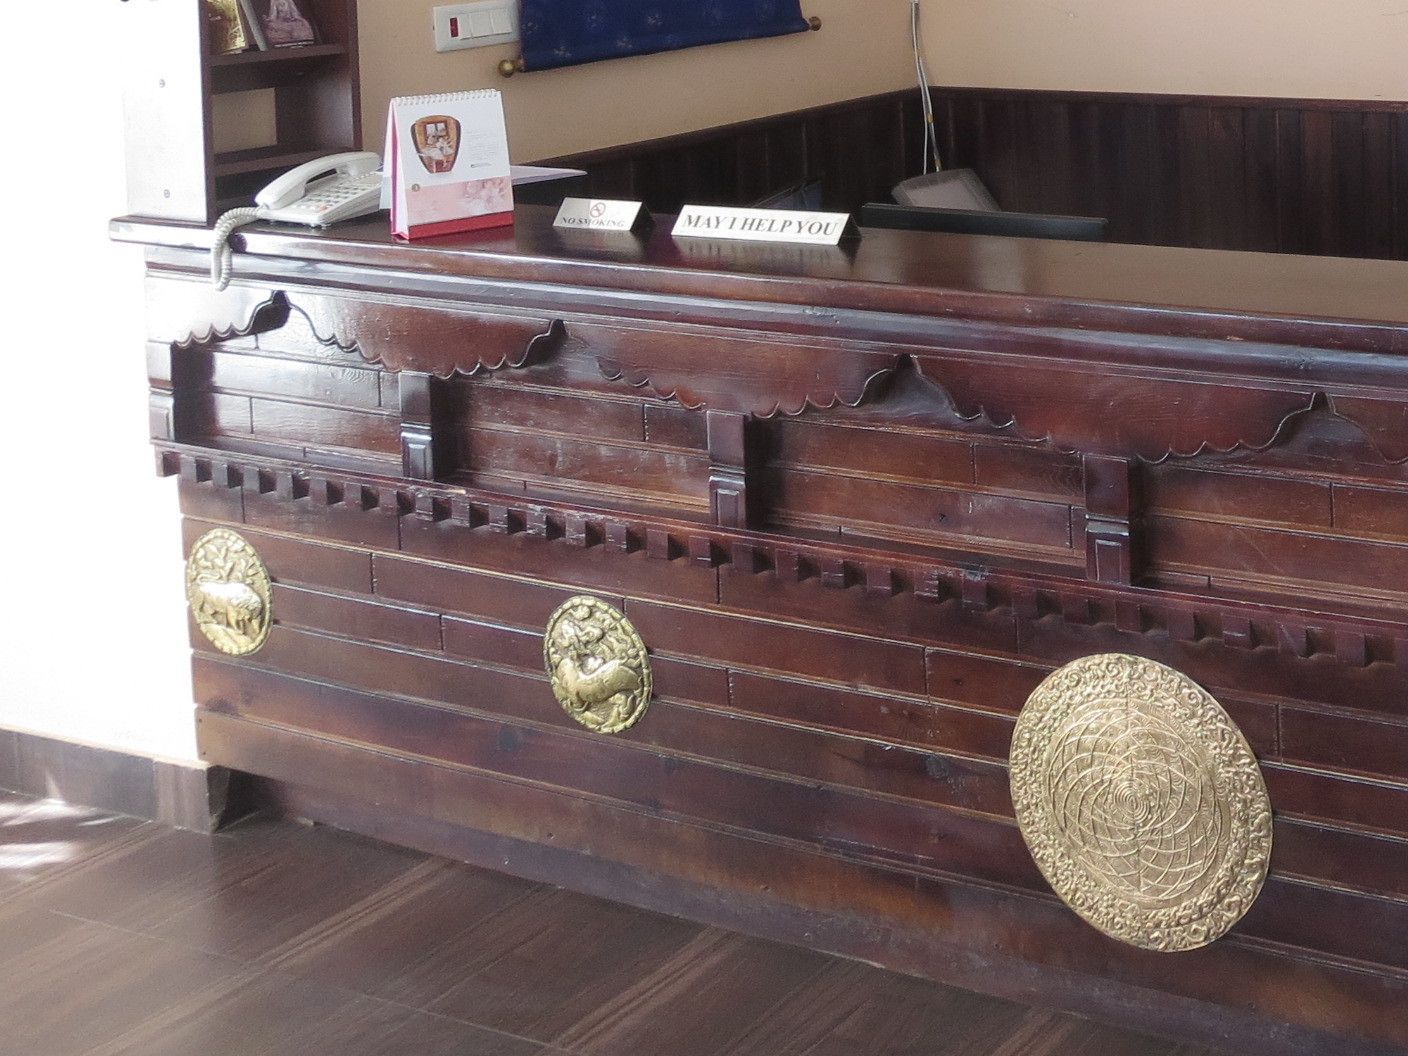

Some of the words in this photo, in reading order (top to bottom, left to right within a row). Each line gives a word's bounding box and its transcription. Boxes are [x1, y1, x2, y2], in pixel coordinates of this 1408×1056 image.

[561, 217, 576, 225] NO
[578, 217, 625, 227] SMOKING
[683, 214, 726, 230] MAY
[728, 216, 738, 230] I
[740, 217, 793, 233] HELP
[795, 220, 839, 236] YOU
